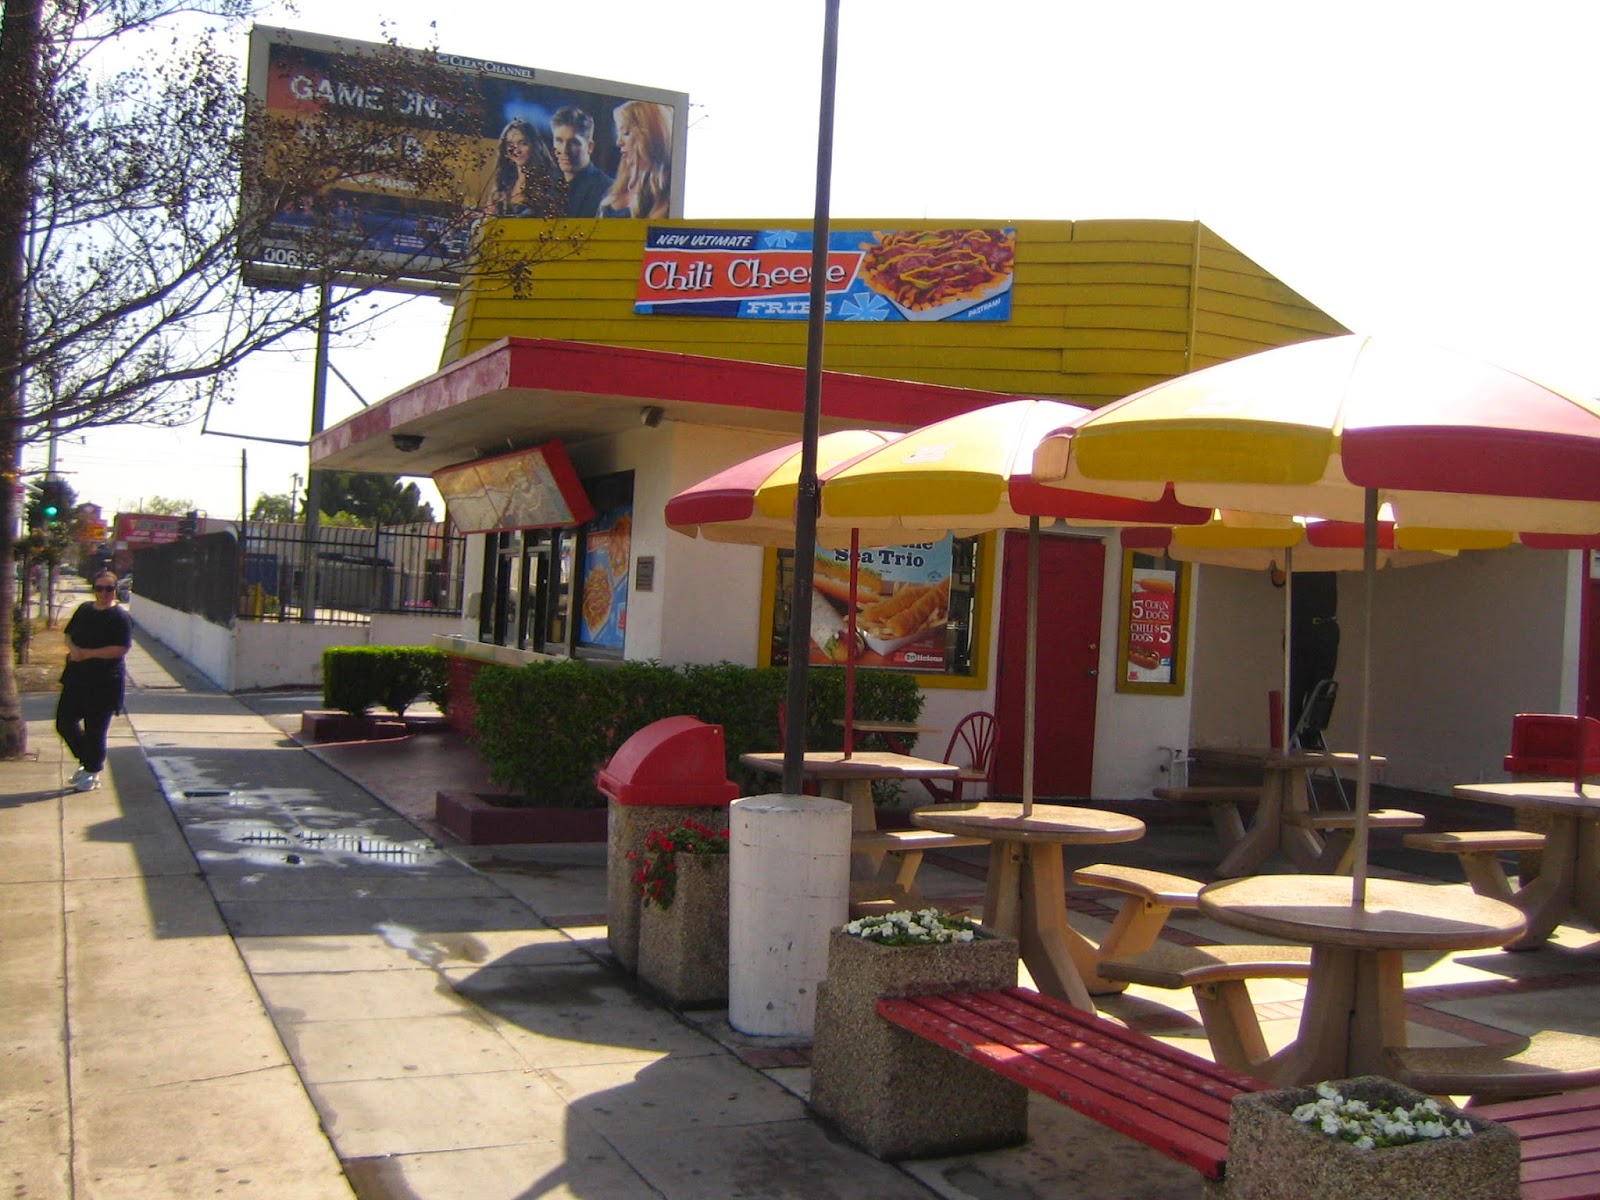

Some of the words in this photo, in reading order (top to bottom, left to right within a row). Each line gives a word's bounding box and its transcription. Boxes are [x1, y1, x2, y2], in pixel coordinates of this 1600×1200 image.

[484, 61, 533, 79] CHANNEL
[290, 74, 385, 111] GAME
[656, 234, 690, 246] NEW
[690, 234, 753, 248] ULTIMATE
[644, 259, 715, 292] Chili
[727, 257, 847, 289] Cheee
[878, 549, 925, 568] Trio
[1132, 600, 1144, 619] 5
[1145, 600, 1169, 610] CORN
[1145, 610, 1169, 620] DOGS
[1131, 623, 1153, 633] CHILI
[1131, 633, 1154, 643] DOGS
